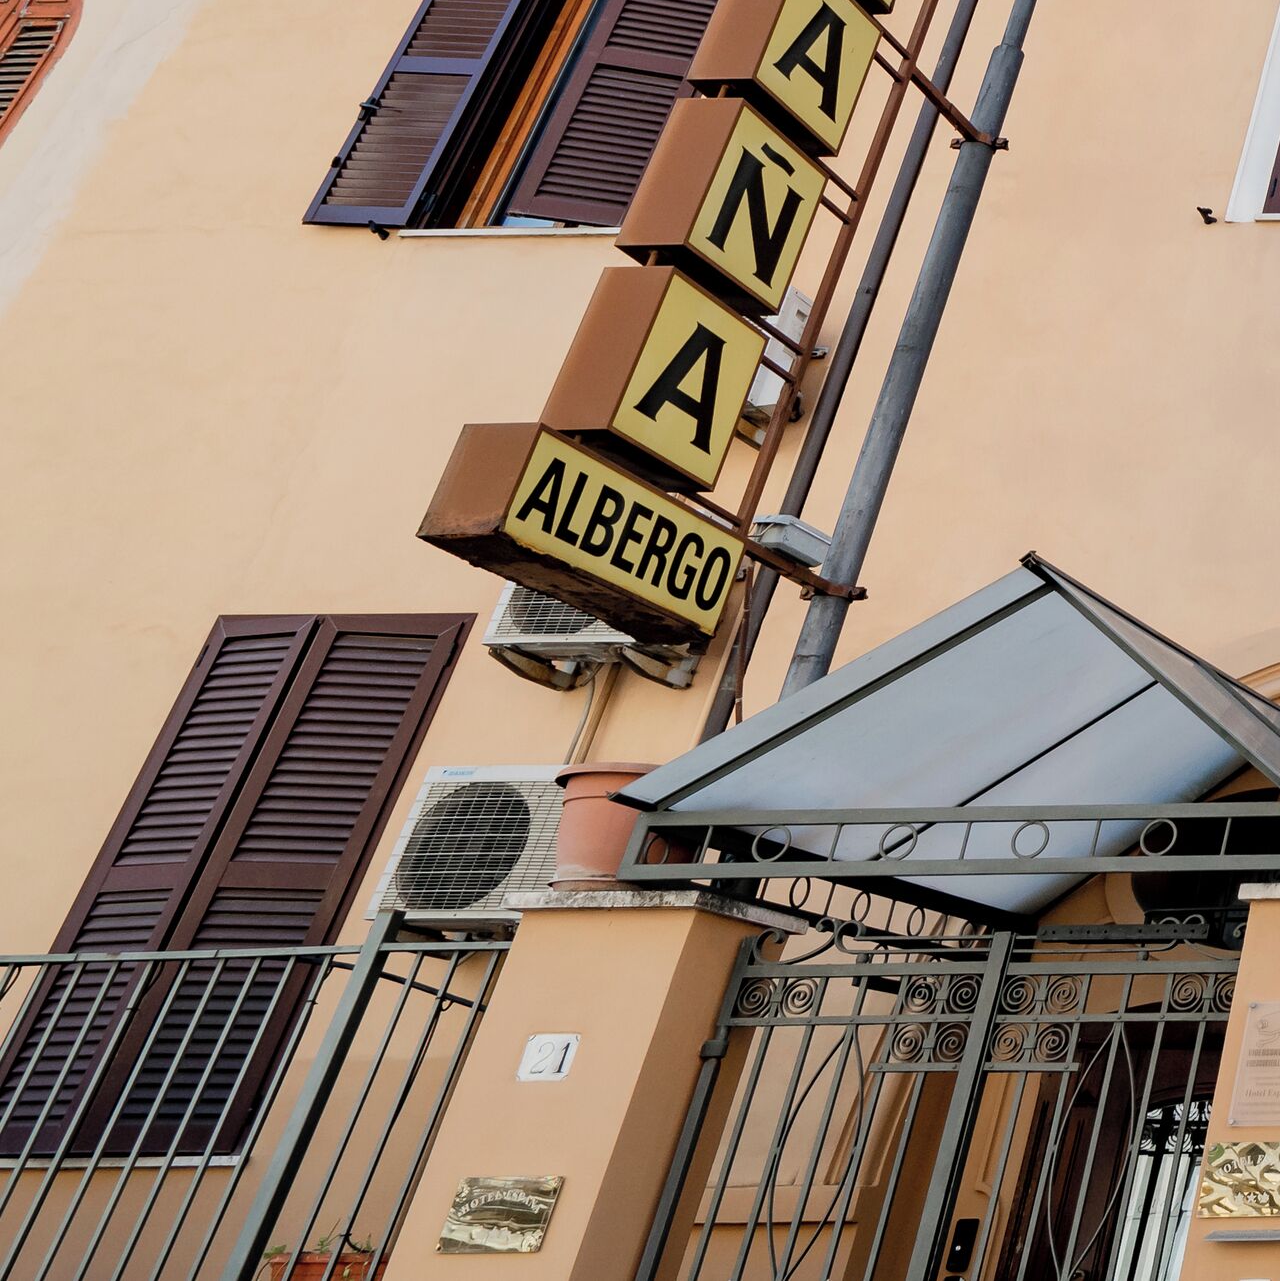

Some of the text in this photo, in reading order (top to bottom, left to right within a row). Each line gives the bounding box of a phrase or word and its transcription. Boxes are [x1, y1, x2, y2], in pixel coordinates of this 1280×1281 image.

[516, 458, 731, 611] ALBERGO
[529, 1041, 571, 1074] 21
[457, 1190, 503, 1217] HOTEL
